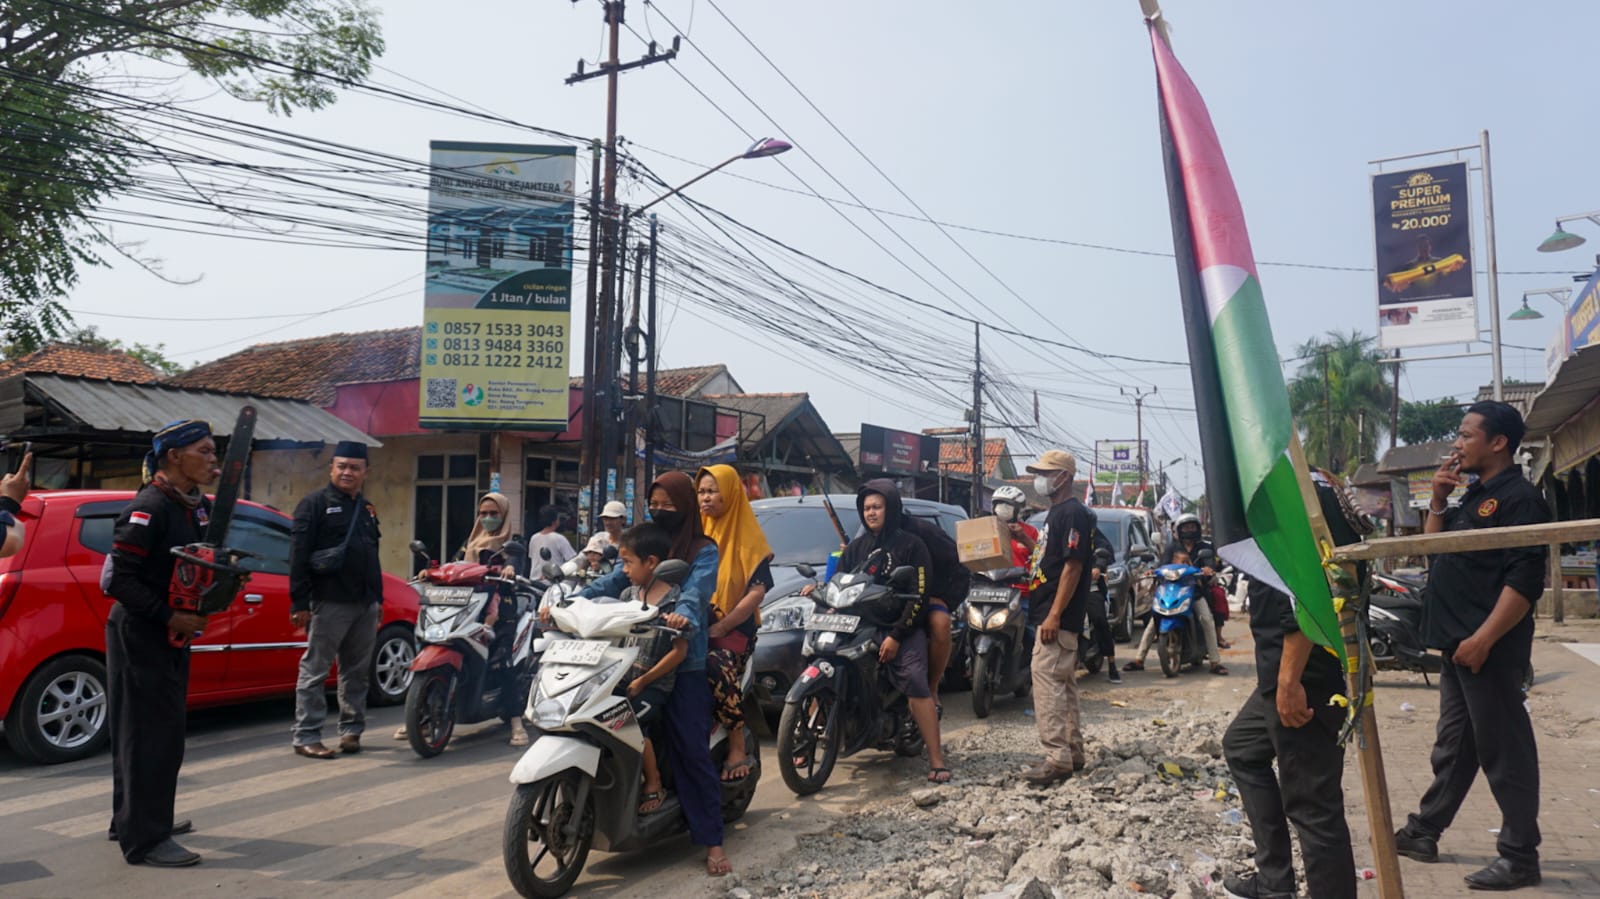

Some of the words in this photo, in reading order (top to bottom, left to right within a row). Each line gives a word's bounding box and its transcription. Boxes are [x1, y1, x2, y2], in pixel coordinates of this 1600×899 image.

[563, 180, 573, 193] 2
[1399, 185, 1441, 198] SUPER
[1391, 194, 1451, 210] PREMIUM
[491, 293, 497, 302] 1
[500, 292, 523, 303] Jtan
[525, 293, 532, 305] /
[535, 293, 566, 304] bulan
[444, 322, 480, 335] 0857
[487, 323, 522, 336] 1533
[527, 324, 564, 337] 3043
[443, 338, 480, 351] 0813
[485, 339, 521, 352] 9484
[527, 341, 564, 353] 3360
[443, 354, 479, 366] 0812
[485, 355, 521, 367] 1222
[526, 356, 563, 368] 2412
